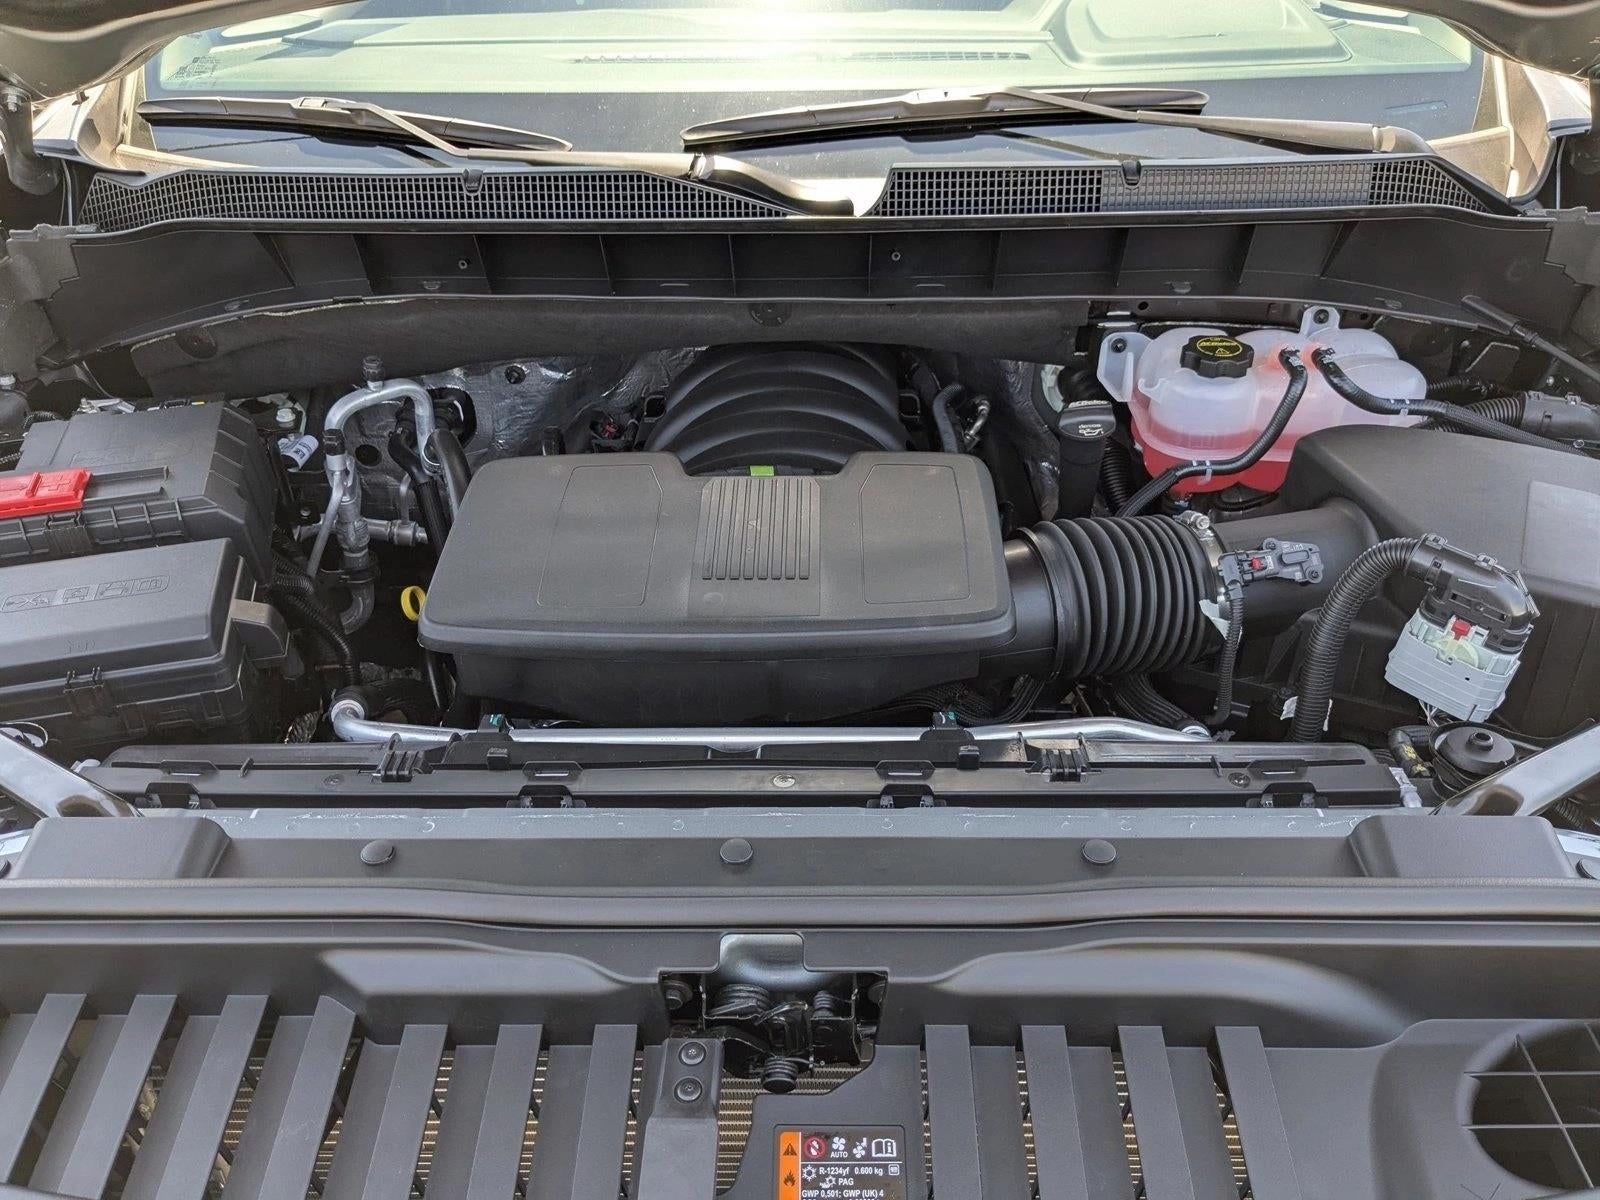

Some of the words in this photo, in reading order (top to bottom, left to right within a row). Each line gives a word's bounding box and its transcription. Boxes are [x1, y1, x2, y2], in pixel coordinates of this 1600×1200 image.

[819, 1166, 850, 1176] R-1234yf
[874, 1167, 884, 1176] kg
[801, 1189, 819, 1197] GWP
[843, 1189, 860, 1197] GWP
[862, 1189, 878, 1199] (UK)
[879, 1189, 884, 1197] 4
